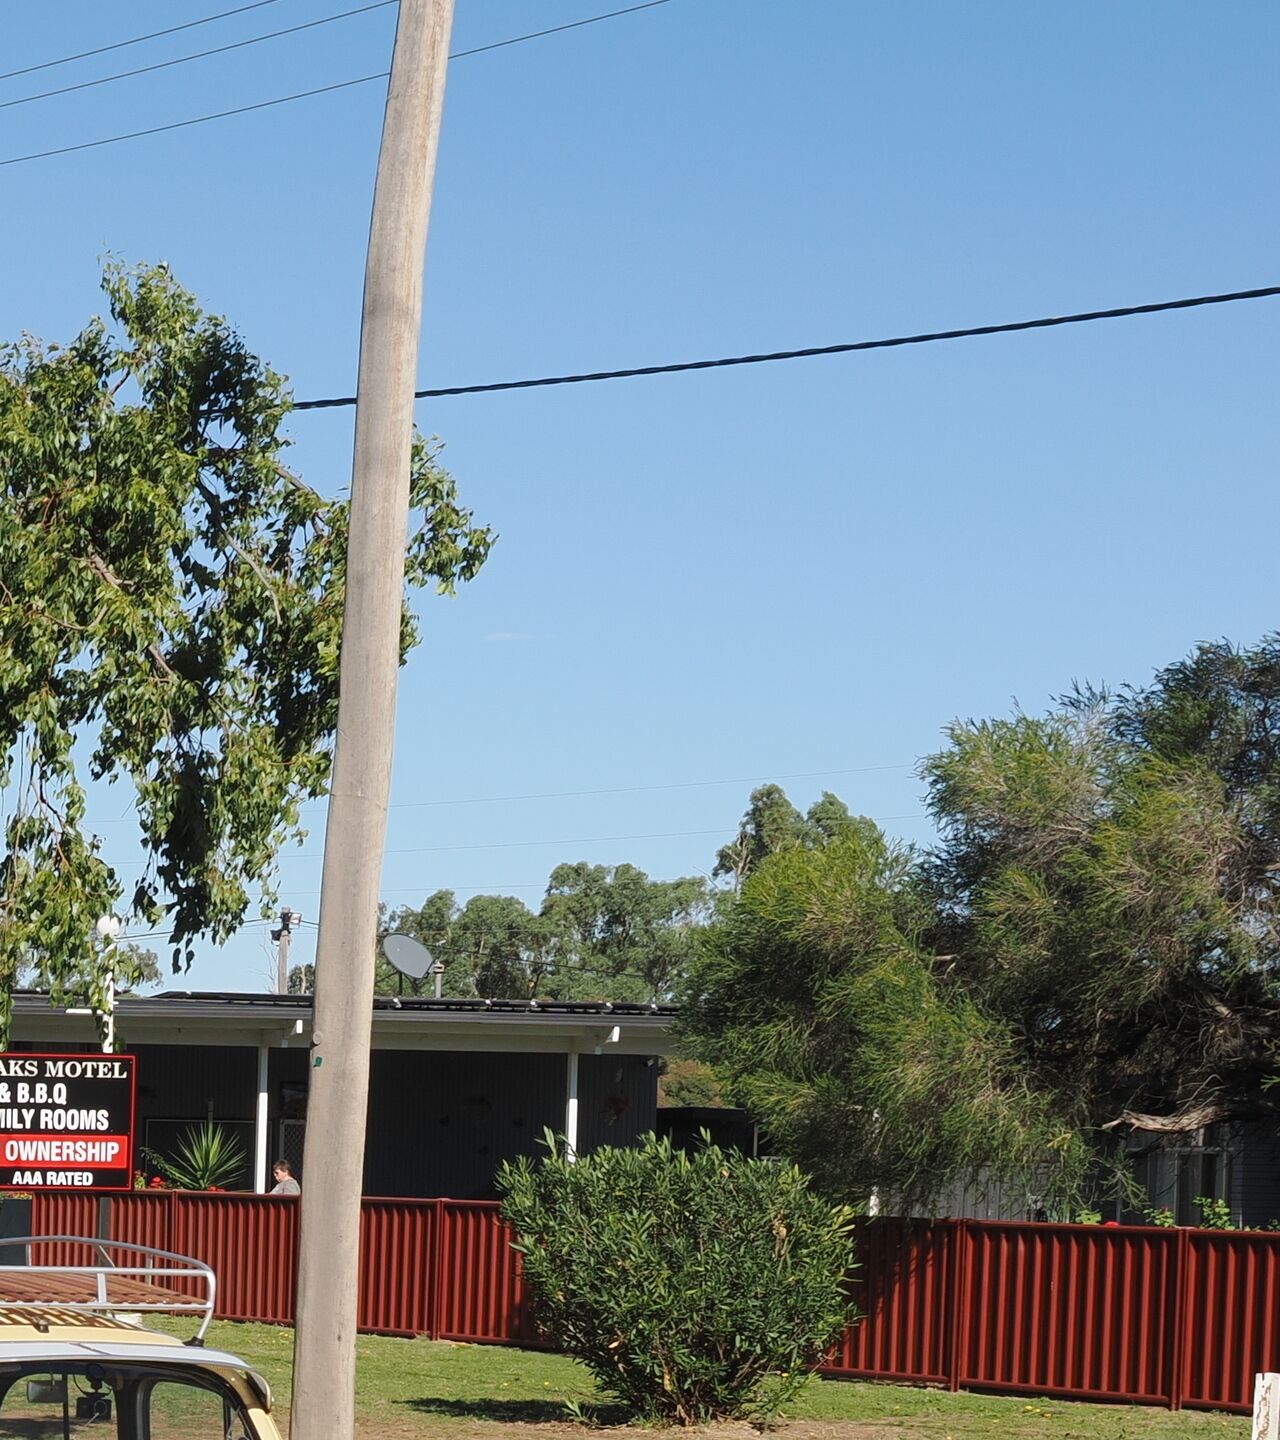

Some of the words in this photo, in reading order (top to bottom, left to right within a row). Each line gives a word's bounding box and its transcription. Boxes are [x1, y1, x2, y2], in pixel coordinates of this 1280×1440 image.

[44, 1060, 127, 1079] MOTEL
[17, 1082, 67, 1105] B.B.Q
[40, 1109, 109, 1130] ROOMS
[5, 1141, 120, 1163] OWNERSHIP
[12, 1170, 43, 1185] AAA
[46, 1171, 93, 1186] RATED
